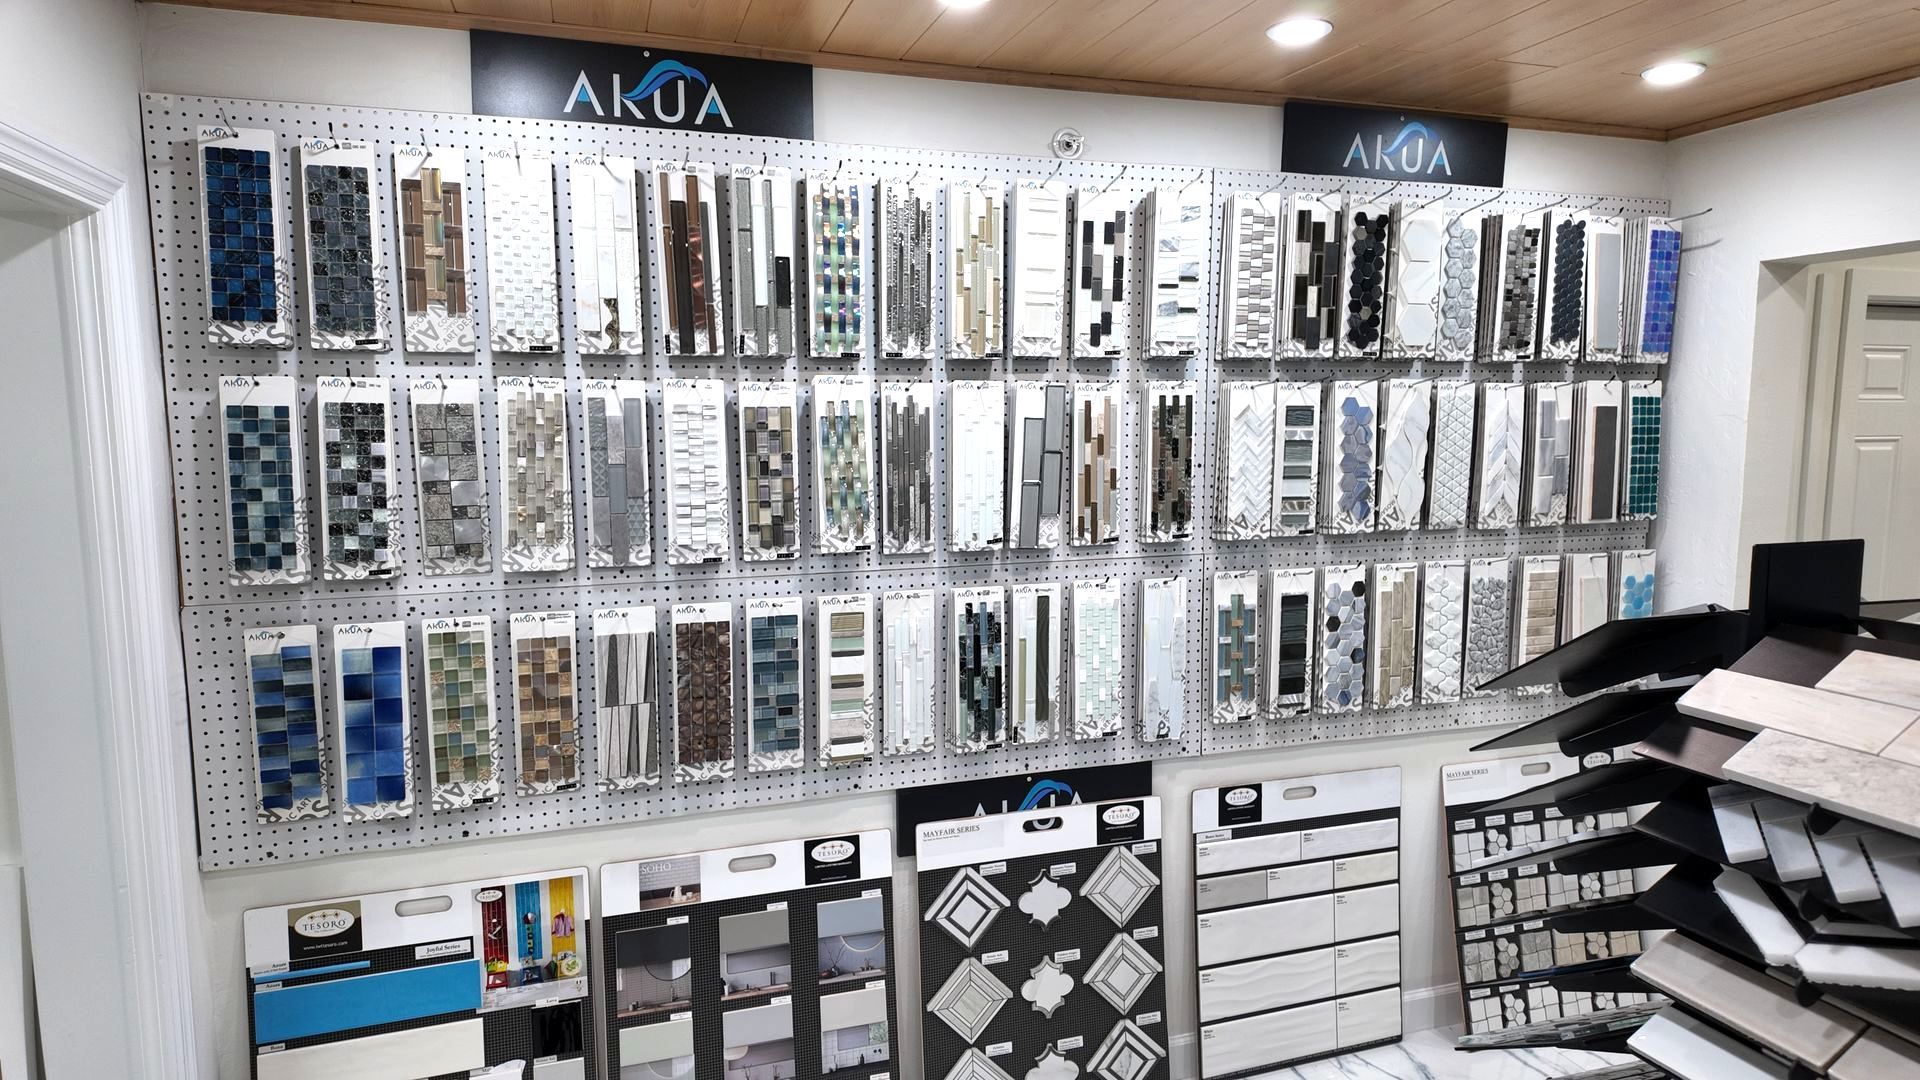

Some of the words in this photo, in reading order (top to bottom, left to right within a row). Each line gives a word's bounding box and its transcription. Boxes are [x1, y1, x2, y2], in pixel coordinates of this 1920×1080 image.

[563, 64, 733, 128] AKUA
[201, 128, 229, 138] AKUA
[303, 141, 329, 150] AKUA
[398, 149, 424, 158] AKUA
[487, 150, 511, 159] AKUA
[1342, 127, 1453, 176] AKUA
[574, 157, 597, 166] AKUA
[655, 164, 678, 172] AKUA
[223, 378, 250, 387] AKUA
[320, 379, 346, 388] AKUA
[413, 382, 438, 390] AKUA
[500, 379, 524, 387] AKUA
[586, 382, 608, 390] AKUA
[666, 380, 688, 388] AKUA
[742, 384, 762, 392] AKUA
[886, 593, 904, 601] AKUA
[957, 590, 975, 598] AKUA
[750, 601, 770, 609] AKUA
[822, 598, 841, 606] AKUA
[598, 610, 620, 619] AKUA
[676, 606, 697, 614] AKUA
[513, 615, 537, 624] AKUA
[338, 625, 363, 635] AKUA
[426, 621, 450, 630] AKUA
[248, 631, 275, 641] AKUA
[1446, 768, 1471, 778] MAYFAIR
[1471, 767, 1489, 776] SERIES
[923, 827, 955, 839] MAYFAIR
[956, 824, 980, 834] SERIES
[817, 848, 848, 857] TESORO
[641, 862, 671, 875] SOHO
[302, 919, 346, 931] TESORO
[425, 945, 443, 954] Joyful
[443, 943, 461, 952] Series
